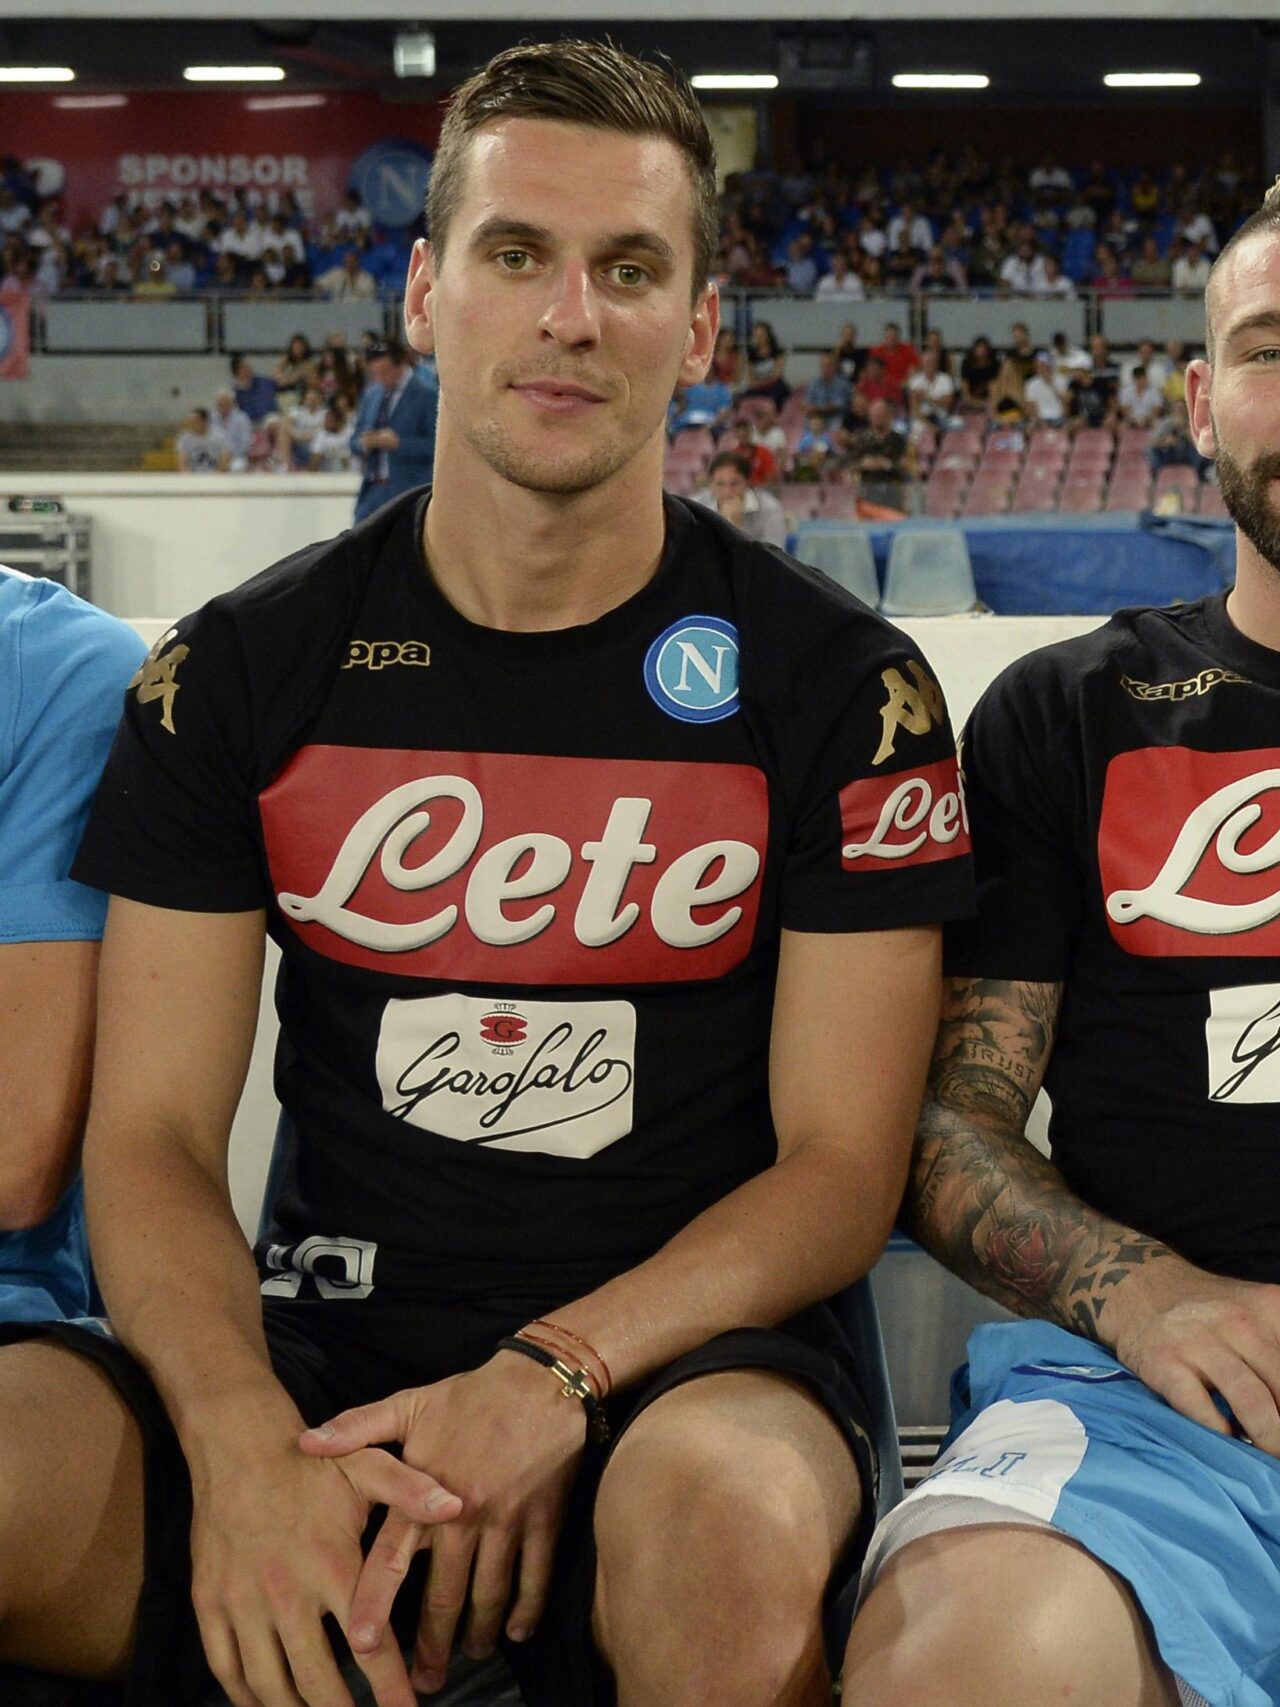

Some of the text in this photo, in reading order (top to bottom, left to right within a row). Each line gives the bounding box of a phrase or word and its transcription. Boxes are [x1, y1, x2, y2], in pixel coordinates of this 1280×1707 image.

[119, 154, 308, 185] SPONSOR
[341, 640, 430, 670] ppa
[673, 640, 730, 695] N
[278, 775, 761, 953] Lete
[385, 1022, 633, 1145] Garofalo
